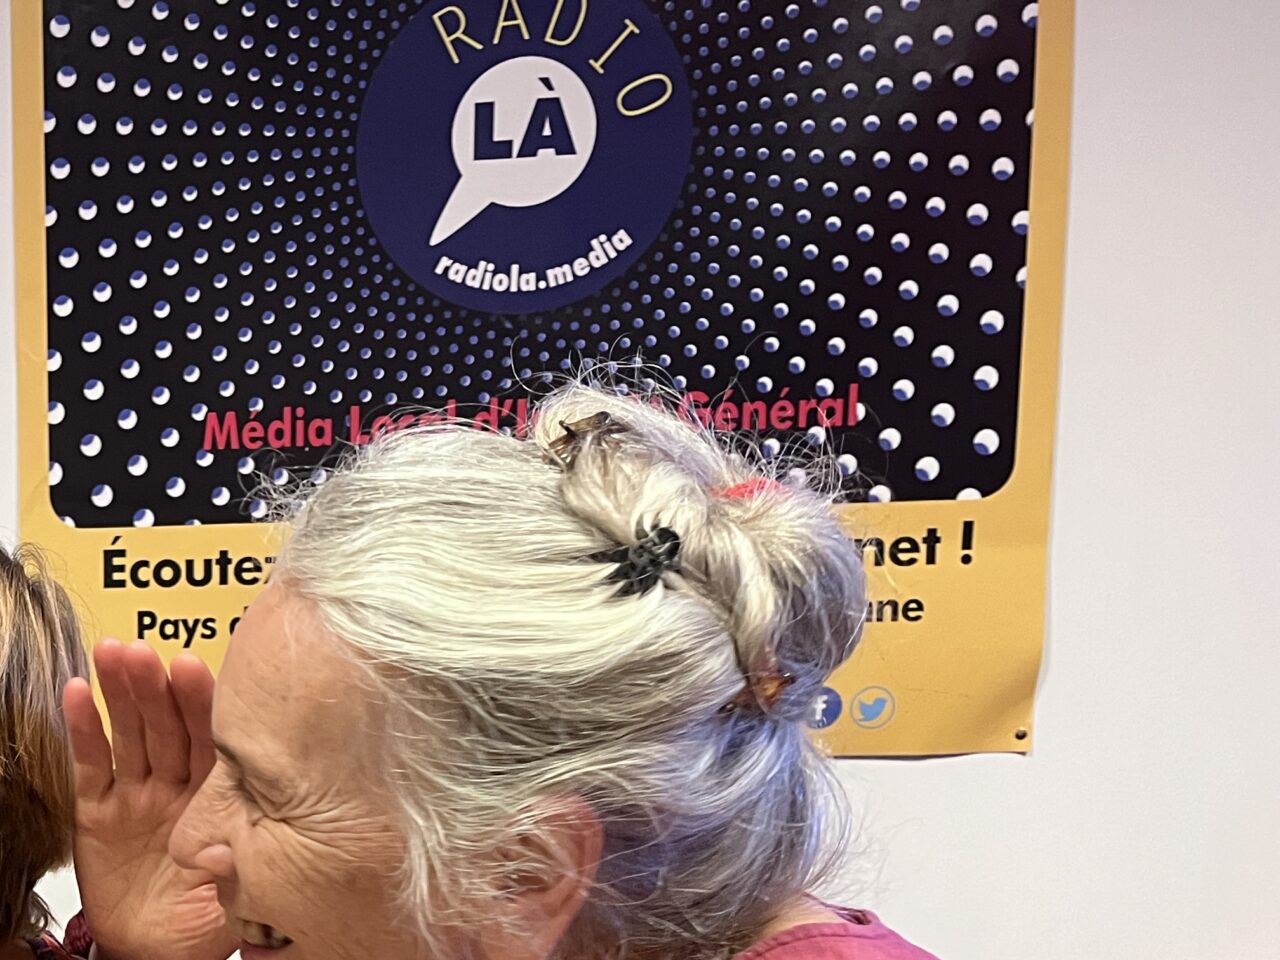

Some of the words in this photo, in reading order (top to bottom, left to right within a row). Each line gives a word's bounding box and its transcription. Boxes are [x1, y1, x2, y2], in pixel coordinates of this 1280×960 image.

[432, 0, 673, 117] RADIO
[473, 77, 577, 161] LÀ
[434, 229, 633, 292] radiola.media
[203, 406, 333, 450] Média
[677, 383, 859, 432] Général
[103, 536, 277, 589] Écoute
[137, 611, 217, 648] Pays
